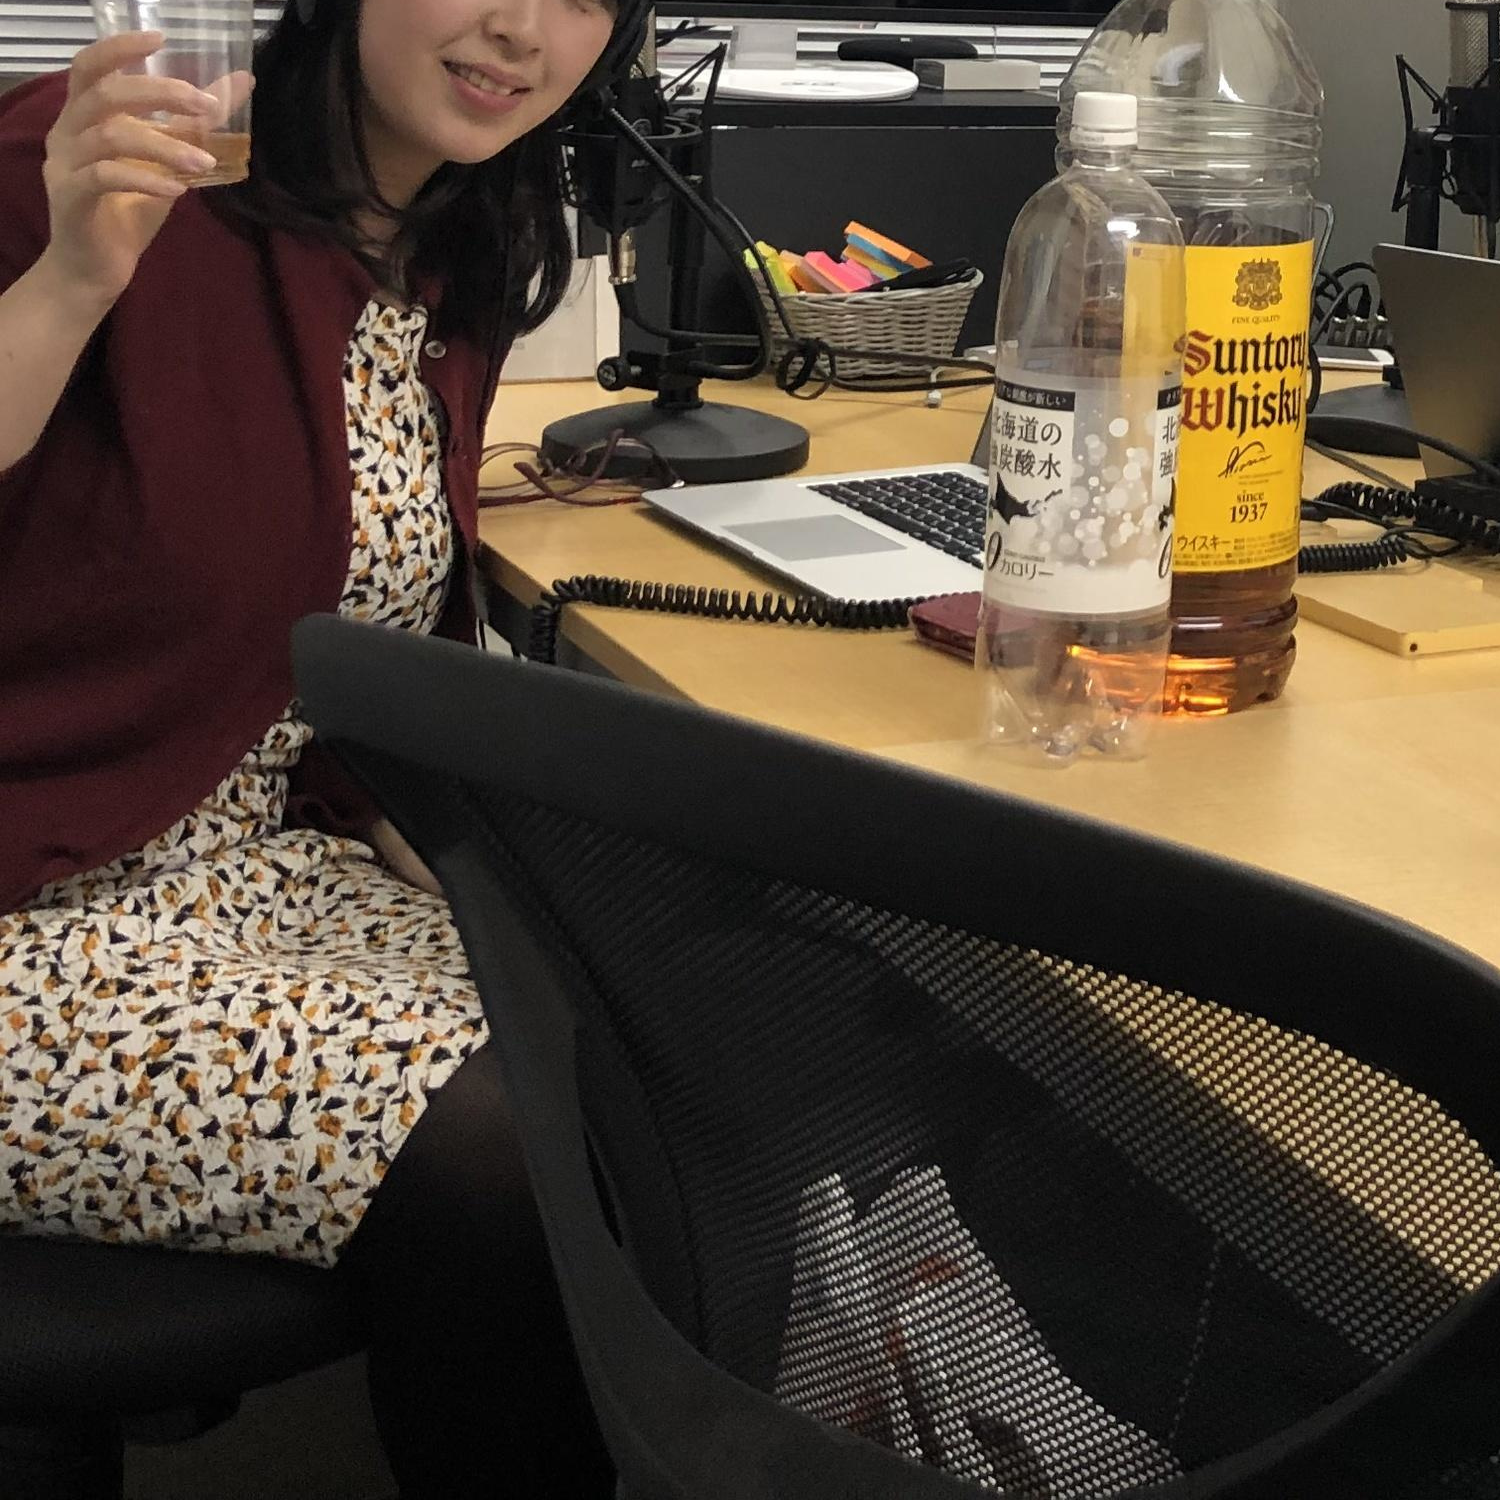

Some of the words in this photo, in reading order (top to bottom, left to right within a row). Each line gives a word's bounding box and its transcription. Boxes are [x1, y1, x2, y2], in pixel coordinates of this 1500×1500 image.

[1175, 330, 1307, 377] Suntory
[1181, 377, 1302, 439] Whisky
[1236, 489, 1265, 503] since
[1230, 502, 1268, 524] 1937
[1177, 534, 1232, 552] ウイスキー
